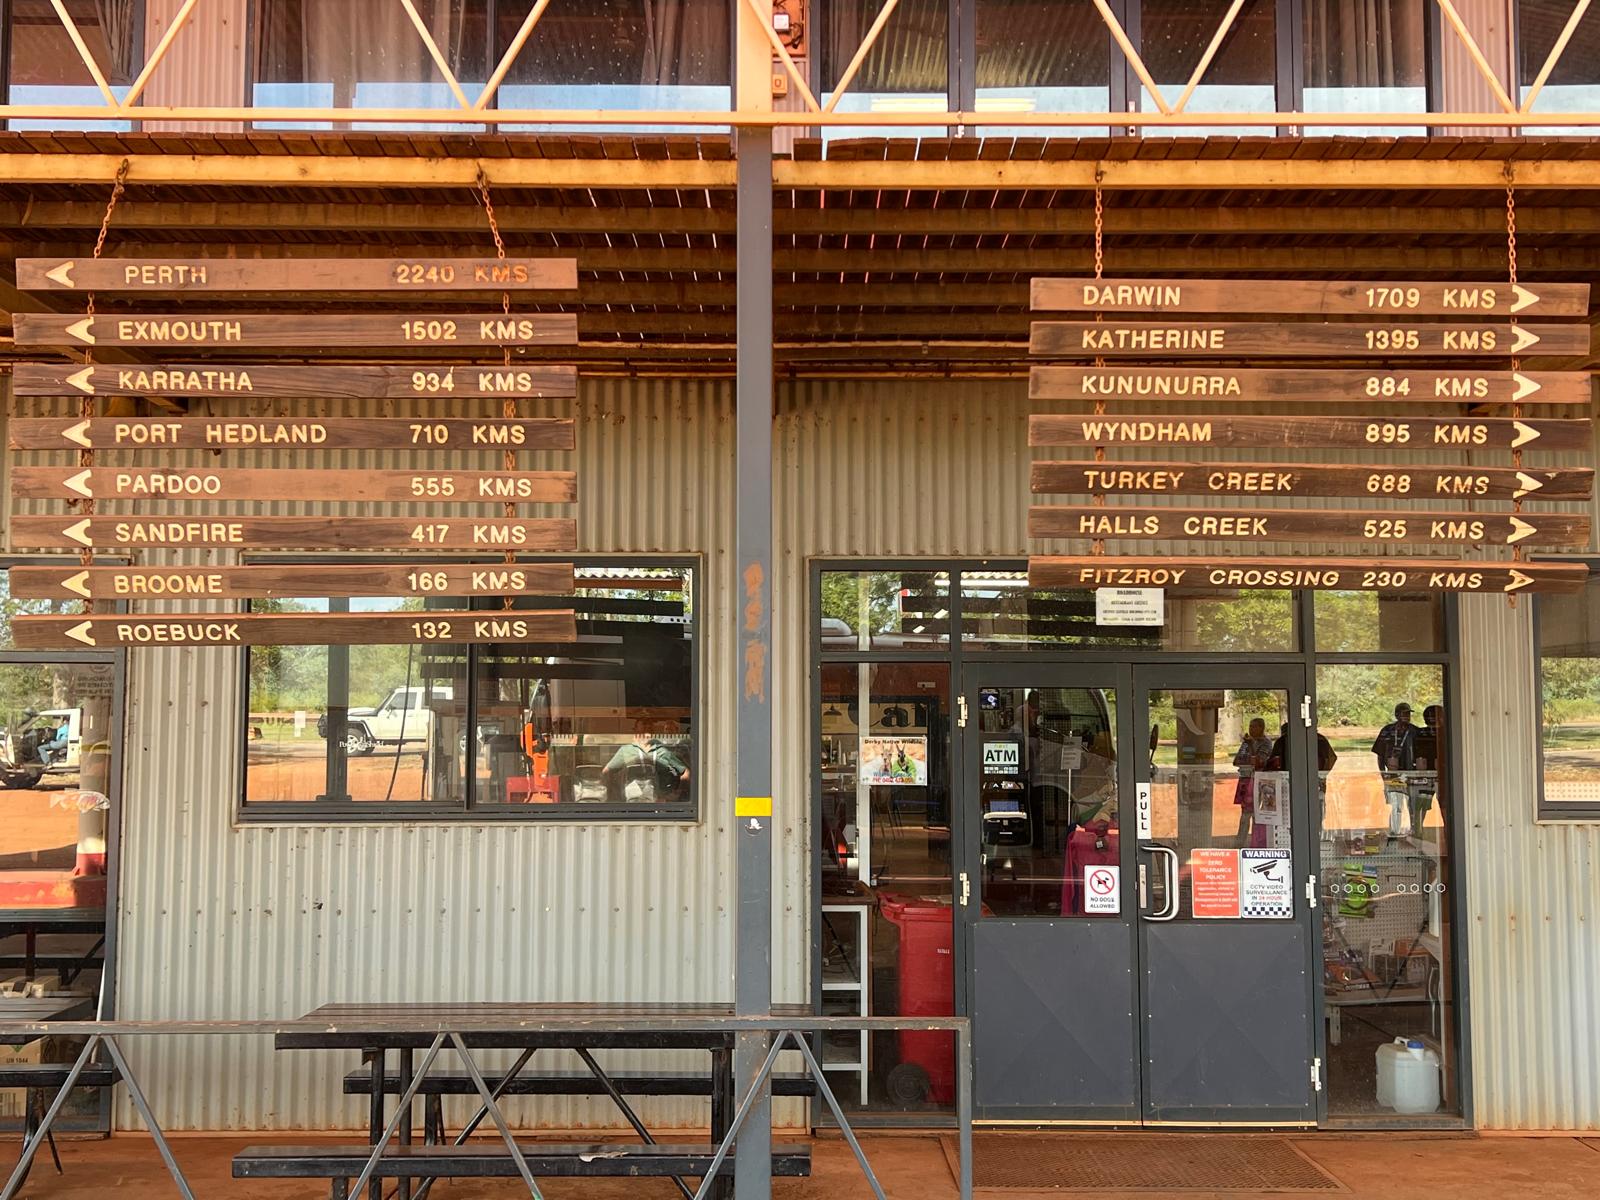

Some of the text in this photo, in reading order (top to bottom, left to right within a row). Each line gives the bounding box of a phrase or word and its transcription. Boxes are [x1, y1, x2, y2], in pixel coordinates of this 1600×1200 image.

[124, 264, 528, 285] PERTH 2240 KMS
[1083, 285, 1496, 309] DARWIN 1709 KMS
[118, 321, 534, 342] EXMOUTH 1502 KMS
[1082, 330, 1497, 350] KATHERINE 1395 KMS
[118, 371, 533, 391] KARRATHA 934 KMS
[1081, 376, 1489, 398] KUNUNURRA 884 KMS
[114, 423, 525, 444] PORT HEDLAND 710 KMS
[1082, 422, 1488, 445] WYNDHAM 895 KMS
[115, 474, 533, 496] PARDOO 555 KMS
[1084, 471, 1490, 495] TURKEY CREEK 688 KMS
[115, 523, 527, 545] SANDFIRE 417 KMS
[1079, 516, 1485, 540] HALLS CREEK 525 KMS
[114, 572, 526, 594] BROOME 166 KMS
[1079, 567, 1484, 589] FITZROY CROSSING 230 KMS
[117, 621, 528, 642] ROEBUCK 132 KMS
[985, 750, 1016, 761] ATM
[1140, 792, 1148, 830] PULL
[1245, 850, 1287, 858] WARNING
